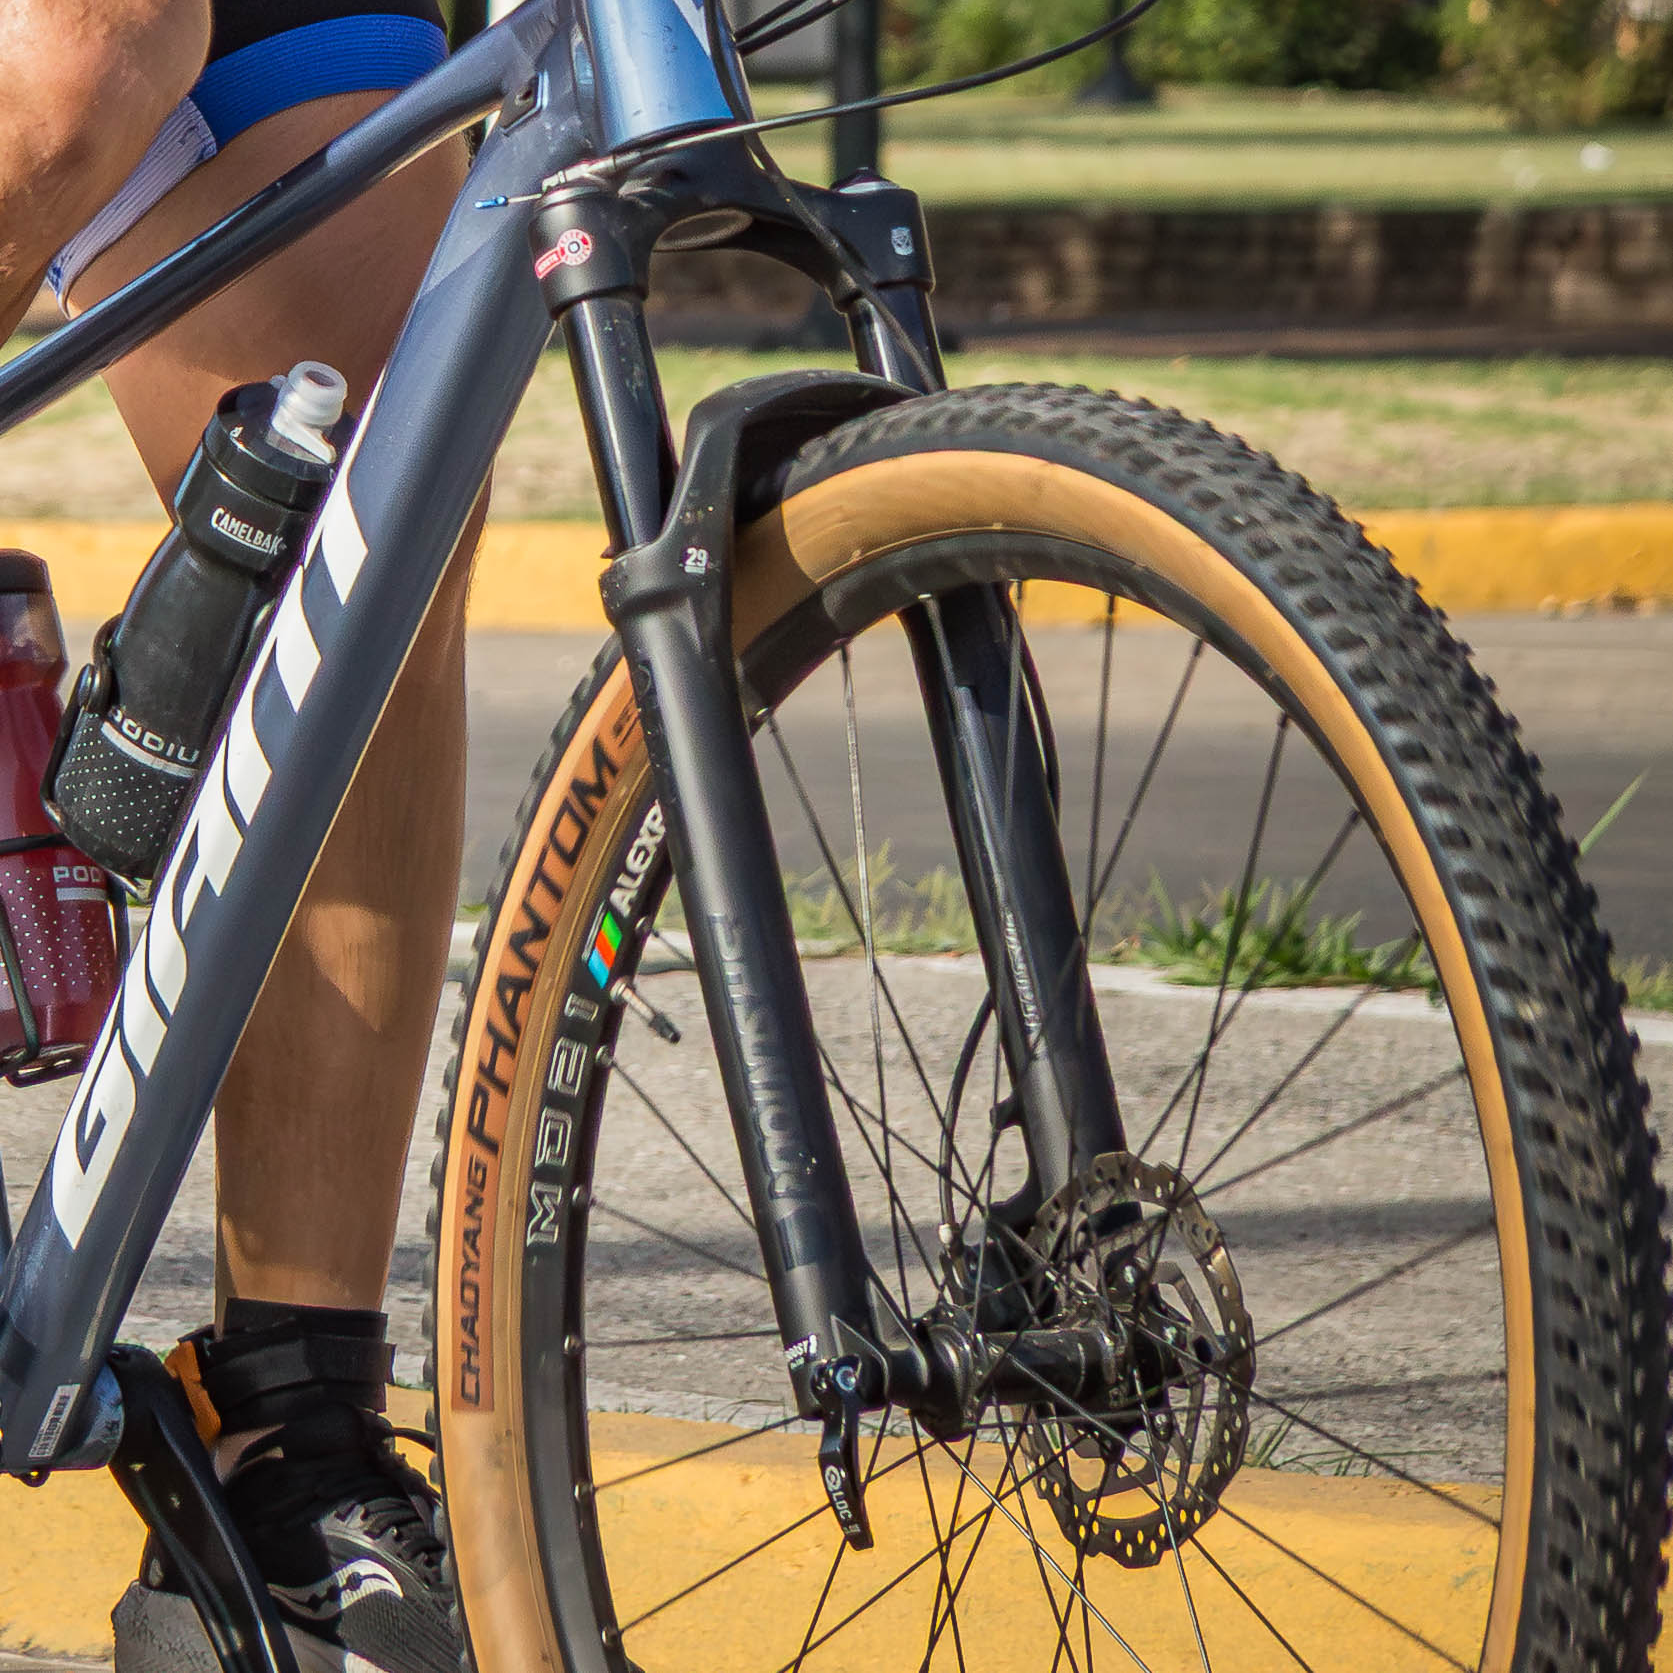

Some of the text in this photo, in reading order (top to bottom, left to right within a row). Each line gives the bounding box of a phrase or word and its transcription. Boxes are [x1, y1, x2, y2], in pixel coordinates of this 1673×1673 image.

[210, 507, 284, 557] CAMELBAK
[685, 547, 708, 567] 29
[107, 704, 201, 764] PODIU
[52, 363, 388, 1249] GIANT
[52, 865, 104, 884] POD
[466, 735, 619, 1155] PHANTOM
[459, 1153, 489, 1407] CHAOYANG
